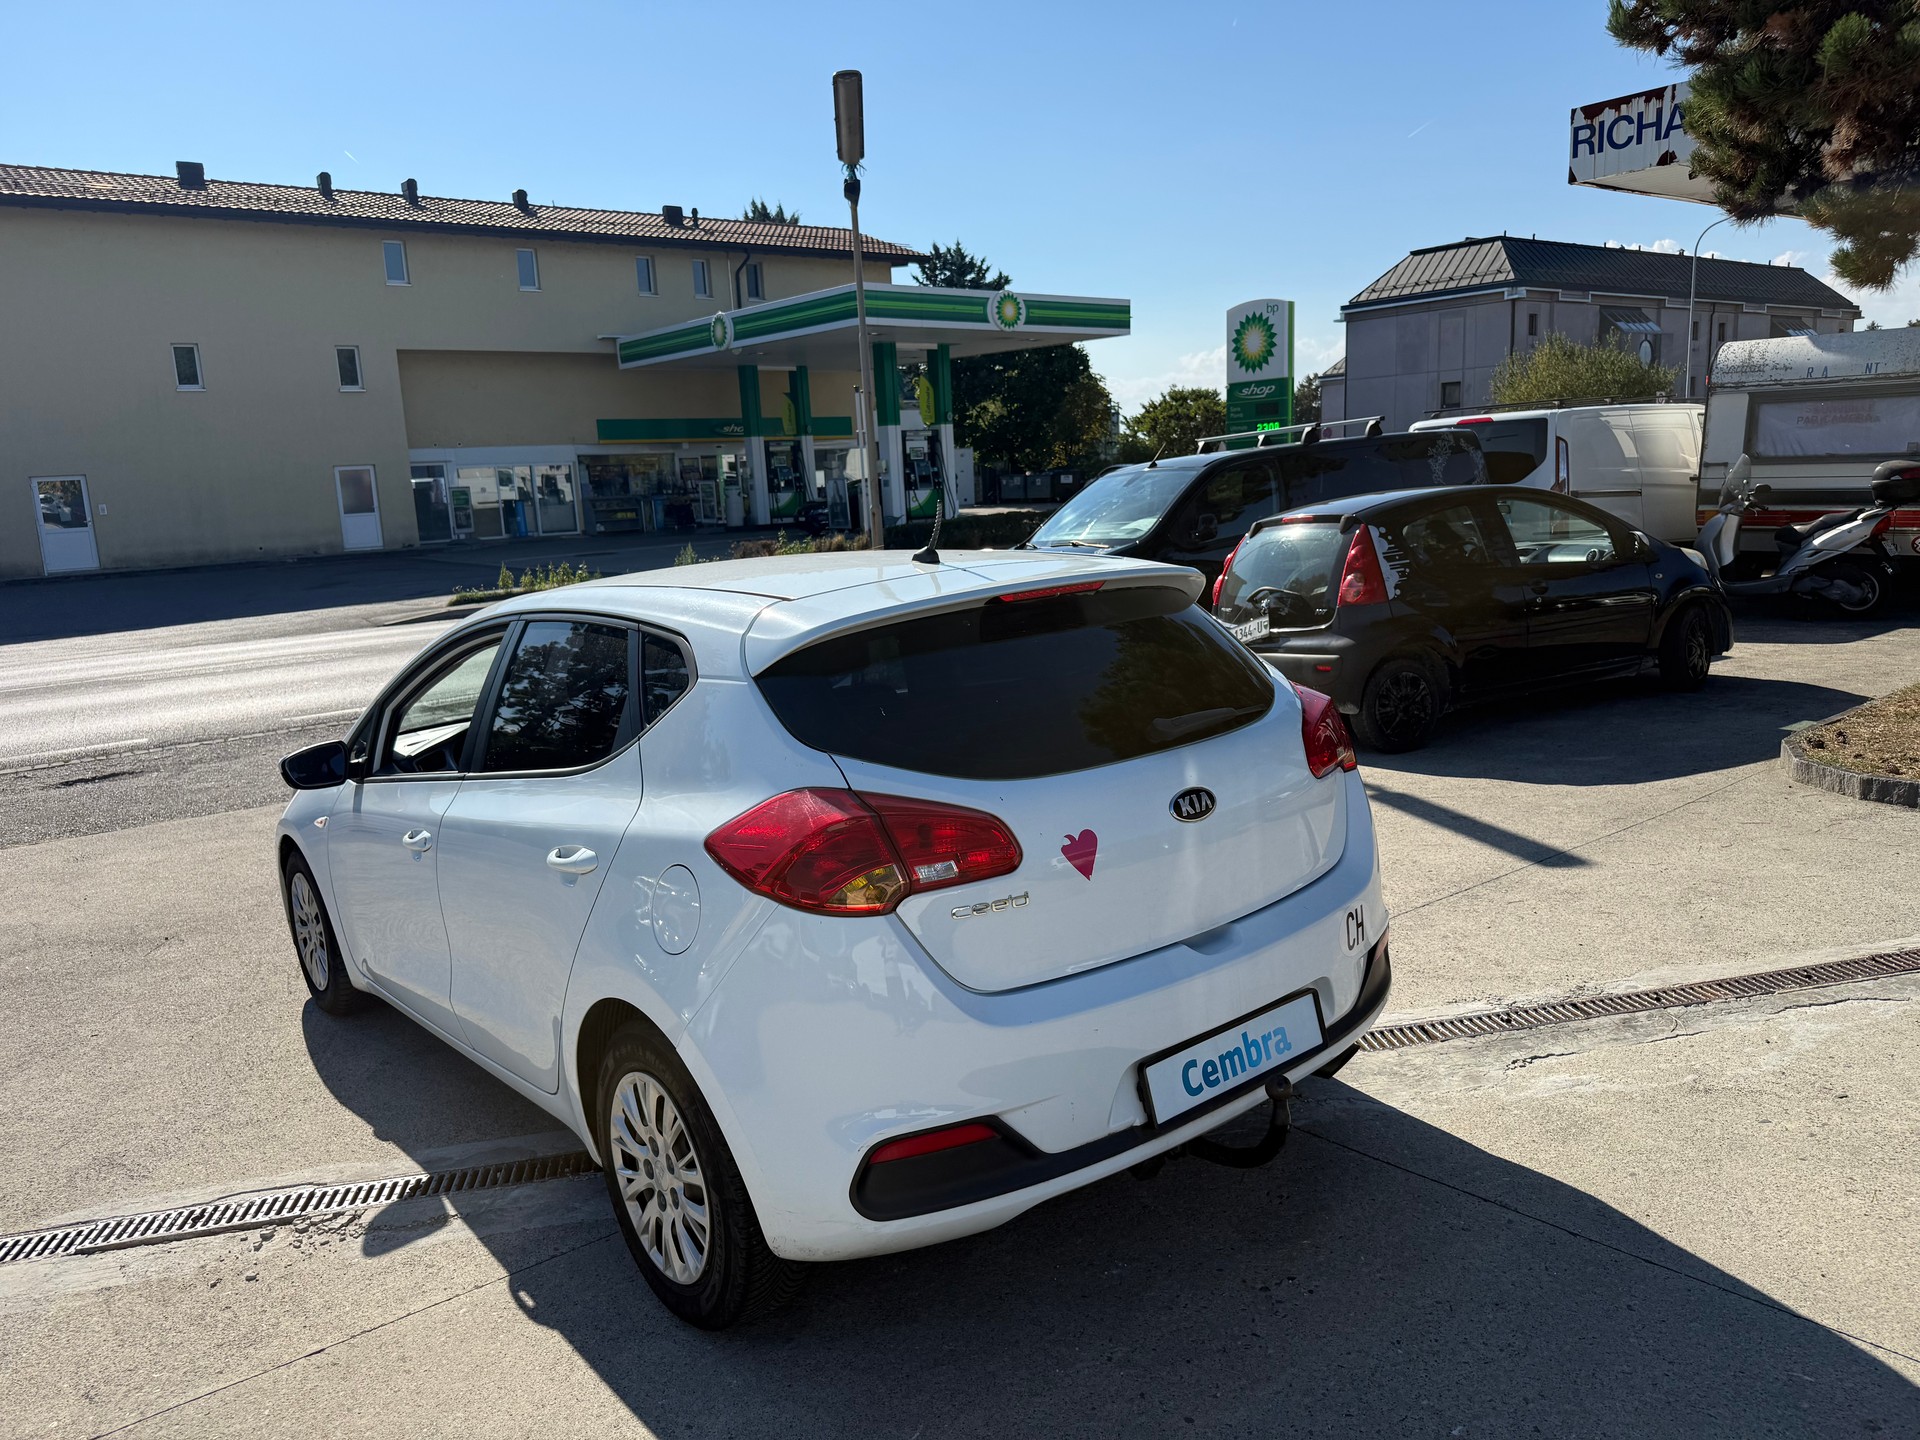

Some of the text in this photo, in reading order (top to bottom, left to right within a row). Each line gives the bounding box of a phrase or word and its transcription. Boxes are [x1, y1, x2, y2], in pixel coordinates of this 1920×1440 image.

[1572, 102, 1687, 159] RICHA
[1266, 303, 1279, 316] bp
[1241, 384, 1276, 397] shop
[722, 424, 744, 433] sho
[1177, 791, 1213, 816] KIA
[1345, 904, 1365, 951] CH
[1181, 1026, 1293, 1097] Cembra
